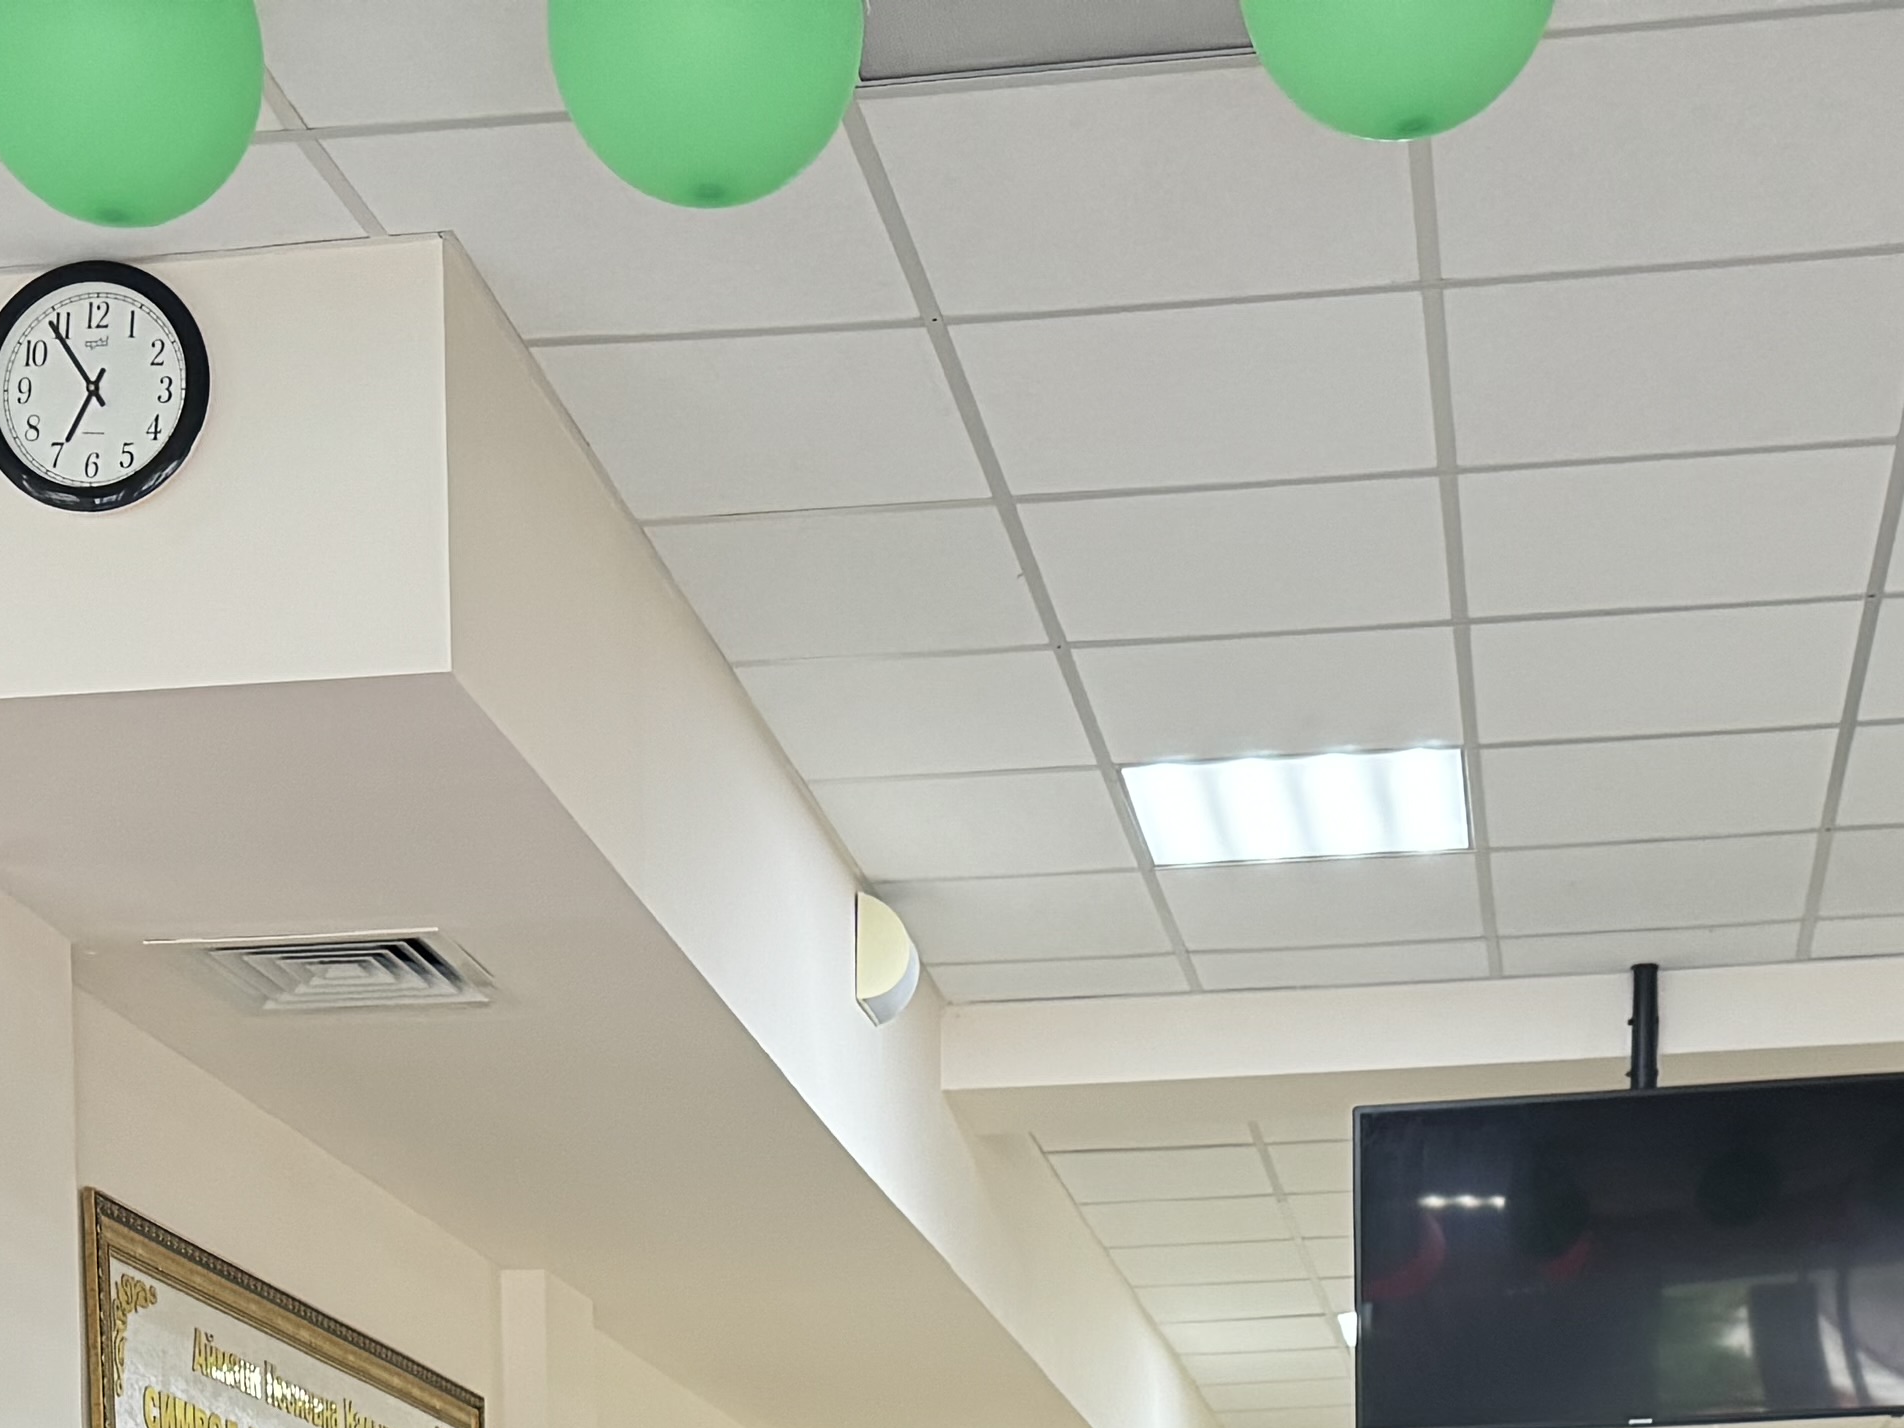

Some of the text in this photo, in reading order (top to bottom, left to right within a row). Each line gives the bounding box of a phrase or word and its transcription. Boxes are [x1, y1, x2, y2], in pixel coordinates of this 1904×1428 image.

[54, 311, 72, 340] 11
[87, 301, 110, 329] 12
[127, 310, 136, 338] 1
[24, 340, 48, 367] 10
[150, 339, 165, 366] 2
[17, 377, 32, 404] 9
[157, 376, 173, 403] 3
[25, 415, 41, 442] 8
[146, 414, 162, 441] 4
[50, 442, 66, 468] 7
[84, 452, 100, 478] 6
[119, 442, 135, 469] 5
